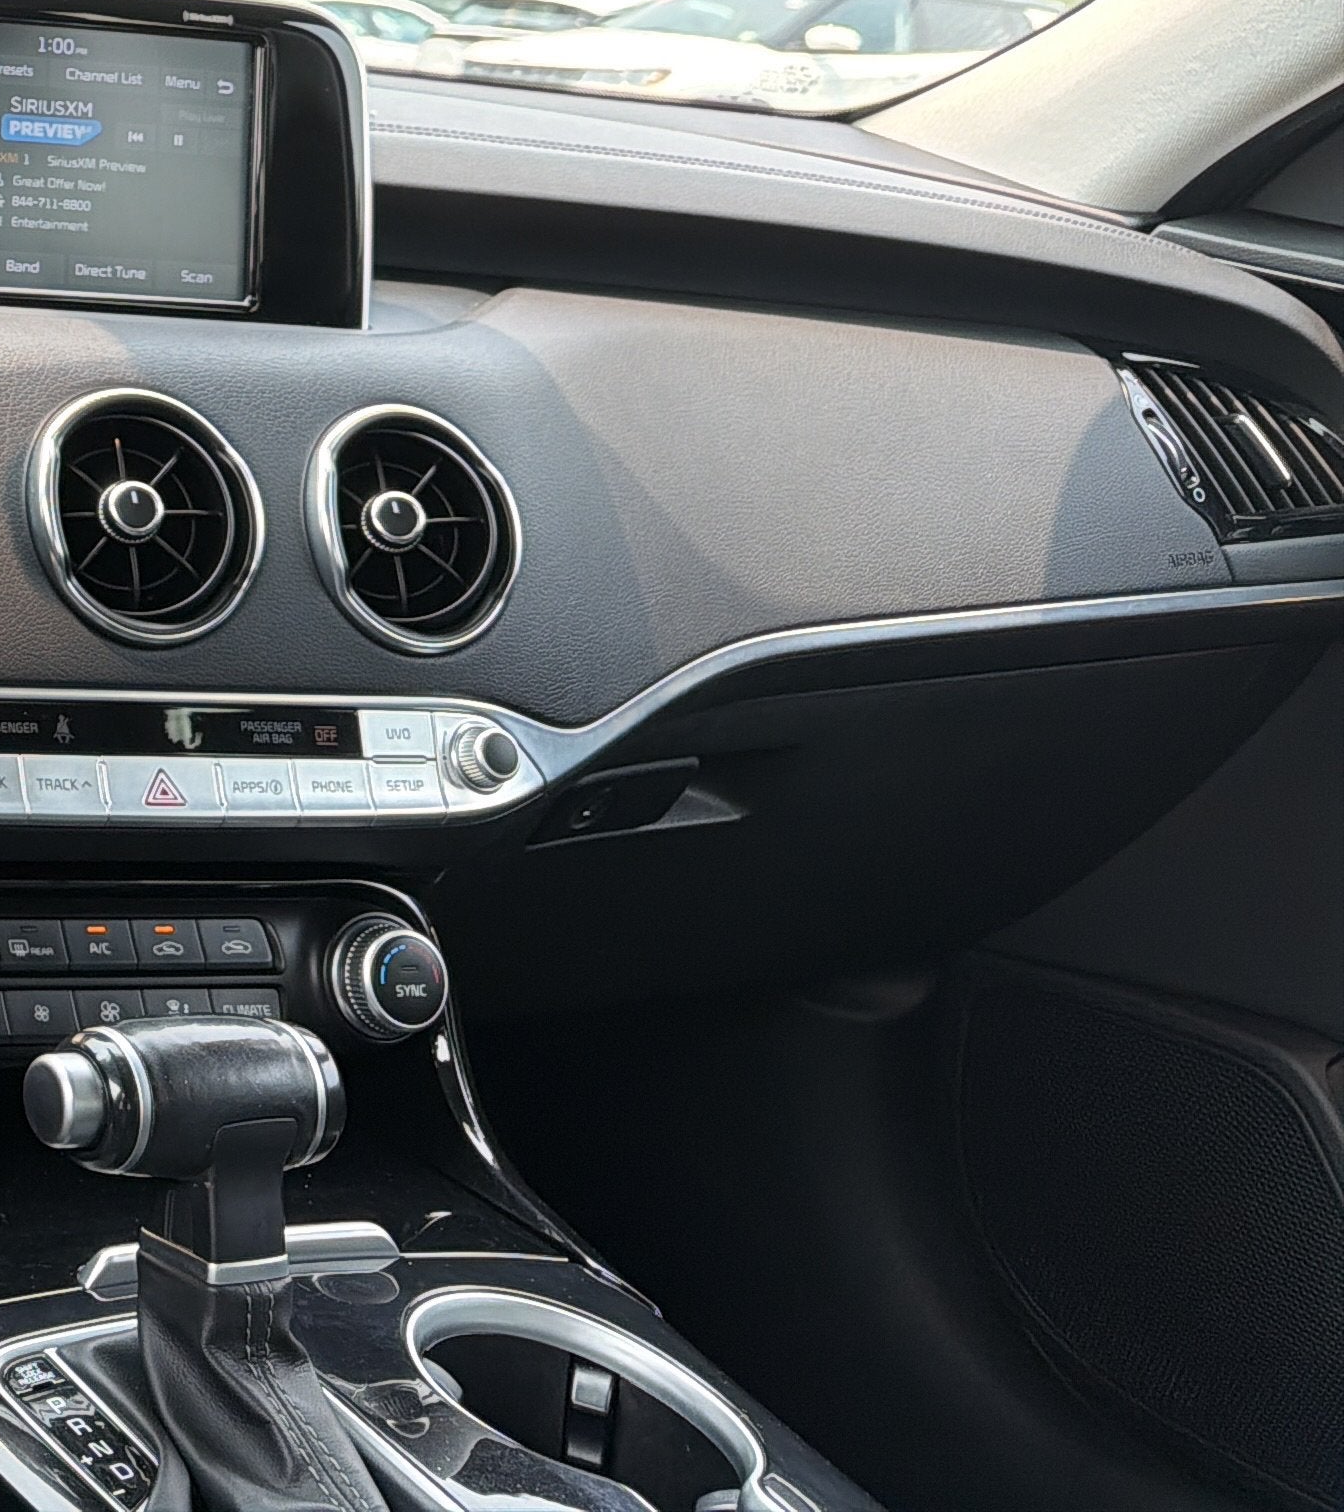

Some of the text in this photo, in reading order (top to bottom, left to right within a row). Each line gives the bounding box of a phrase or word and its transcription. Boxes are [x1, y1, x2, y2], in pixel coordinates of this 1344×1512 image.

[65, 67, 143, 85] Channel List
[165, 75, 201, 90] Menu
[8, 120, 92, 140] PREVIEW
[23, 153, 30, 165] 1
[47, 155, 146, 173] SiriusXM Preview
[12, 174, 45, 188] Great
[47, 177, 75, 190] Offer
[11, 216, 89, 232] Entertainment
[5, 259, 41, 274] Band
[74, 263, 147, 280] Direct Tune
[180, 269, 213, 284] Scan
[240, 720, 302, 734] PASSENGER
[385, 727, 412, 740] UVO
[252, 732, 293, 746] AIR BAG
[314, 728, 338, 743] OFF
[35, 777, 78, 792] TRACK
[312, 779, 355, 794] PHONE
[385, 779, 425, 793] SETUP
[30, 946, 55, 957] REAR
[88, 941, 113, 955] A/C
[394, 984, 428, 998] SYNC
[46, 1396, 68, 1415] P
[66, 1416, 94, 1437] R
[88, 1438, 116, 1459] N
[109, 1462, 135, 1481] D
